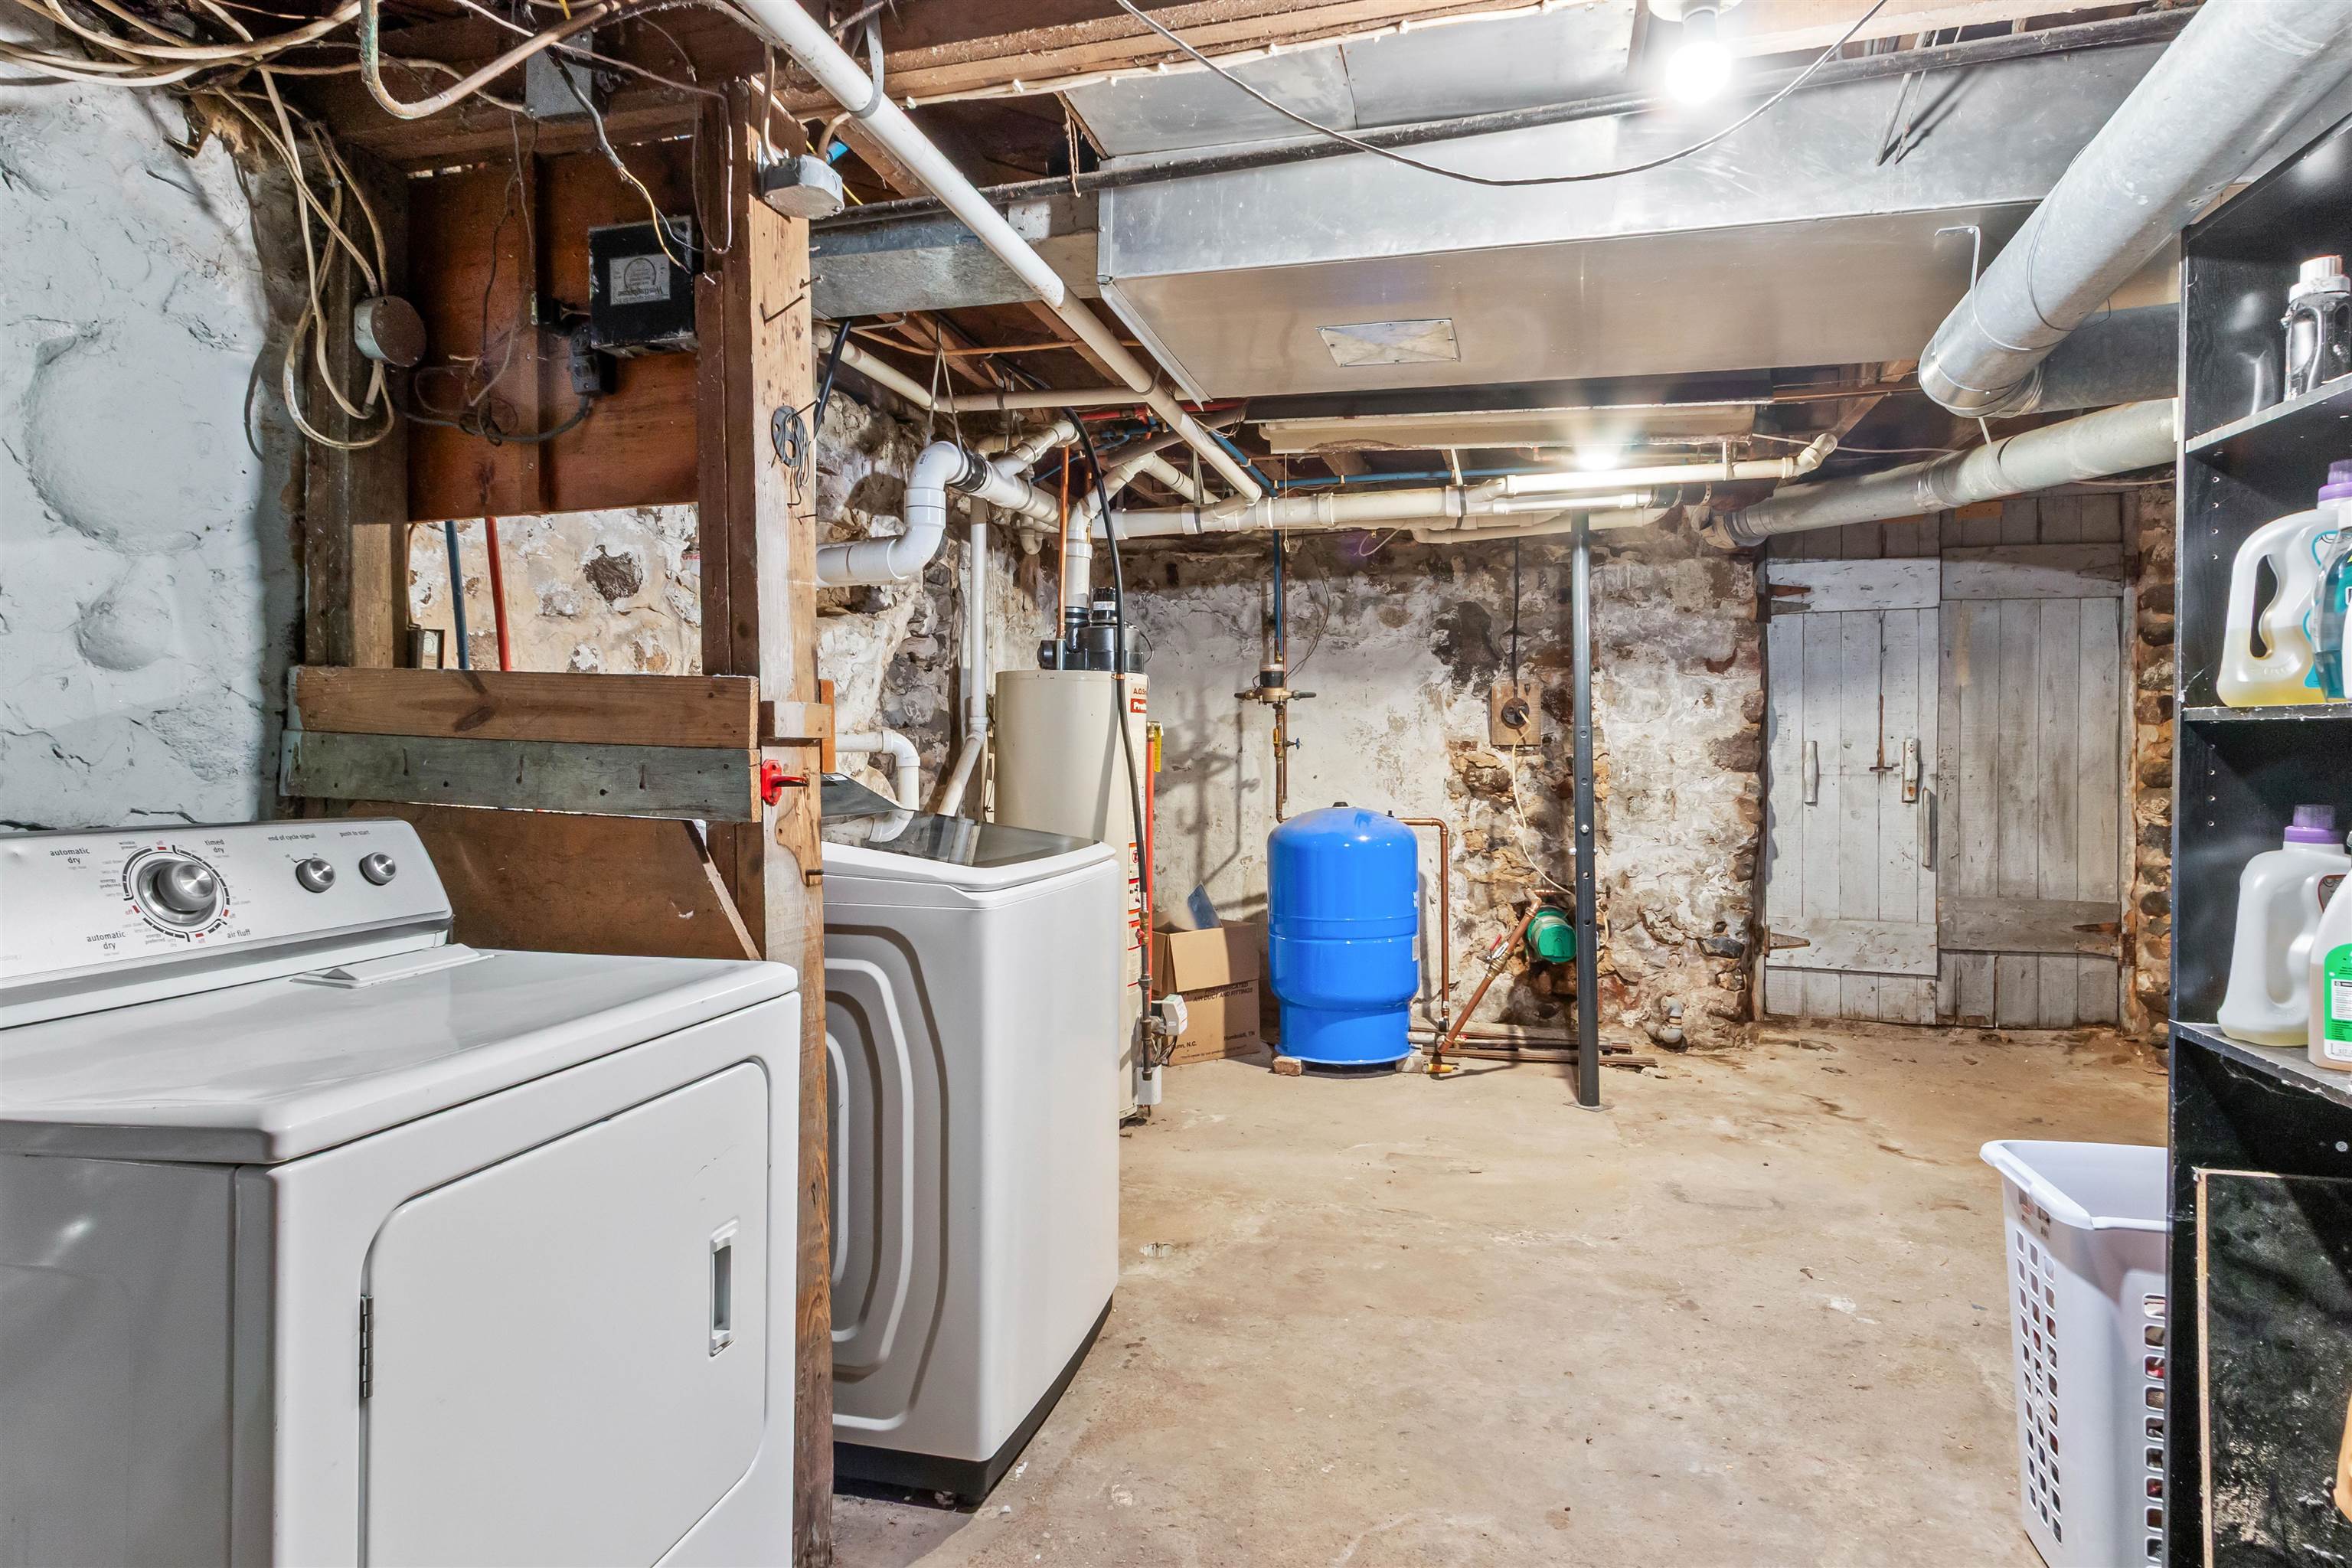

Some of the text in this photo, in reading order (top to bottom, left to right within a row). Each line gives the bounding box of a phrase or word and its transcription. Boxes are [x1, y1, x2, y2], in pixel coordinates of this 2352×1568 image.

[50, 847, 90, 857] automatic
[87, 930, 126, 942] automatic
[1231, 987, 1253, 996] FITTINGS
